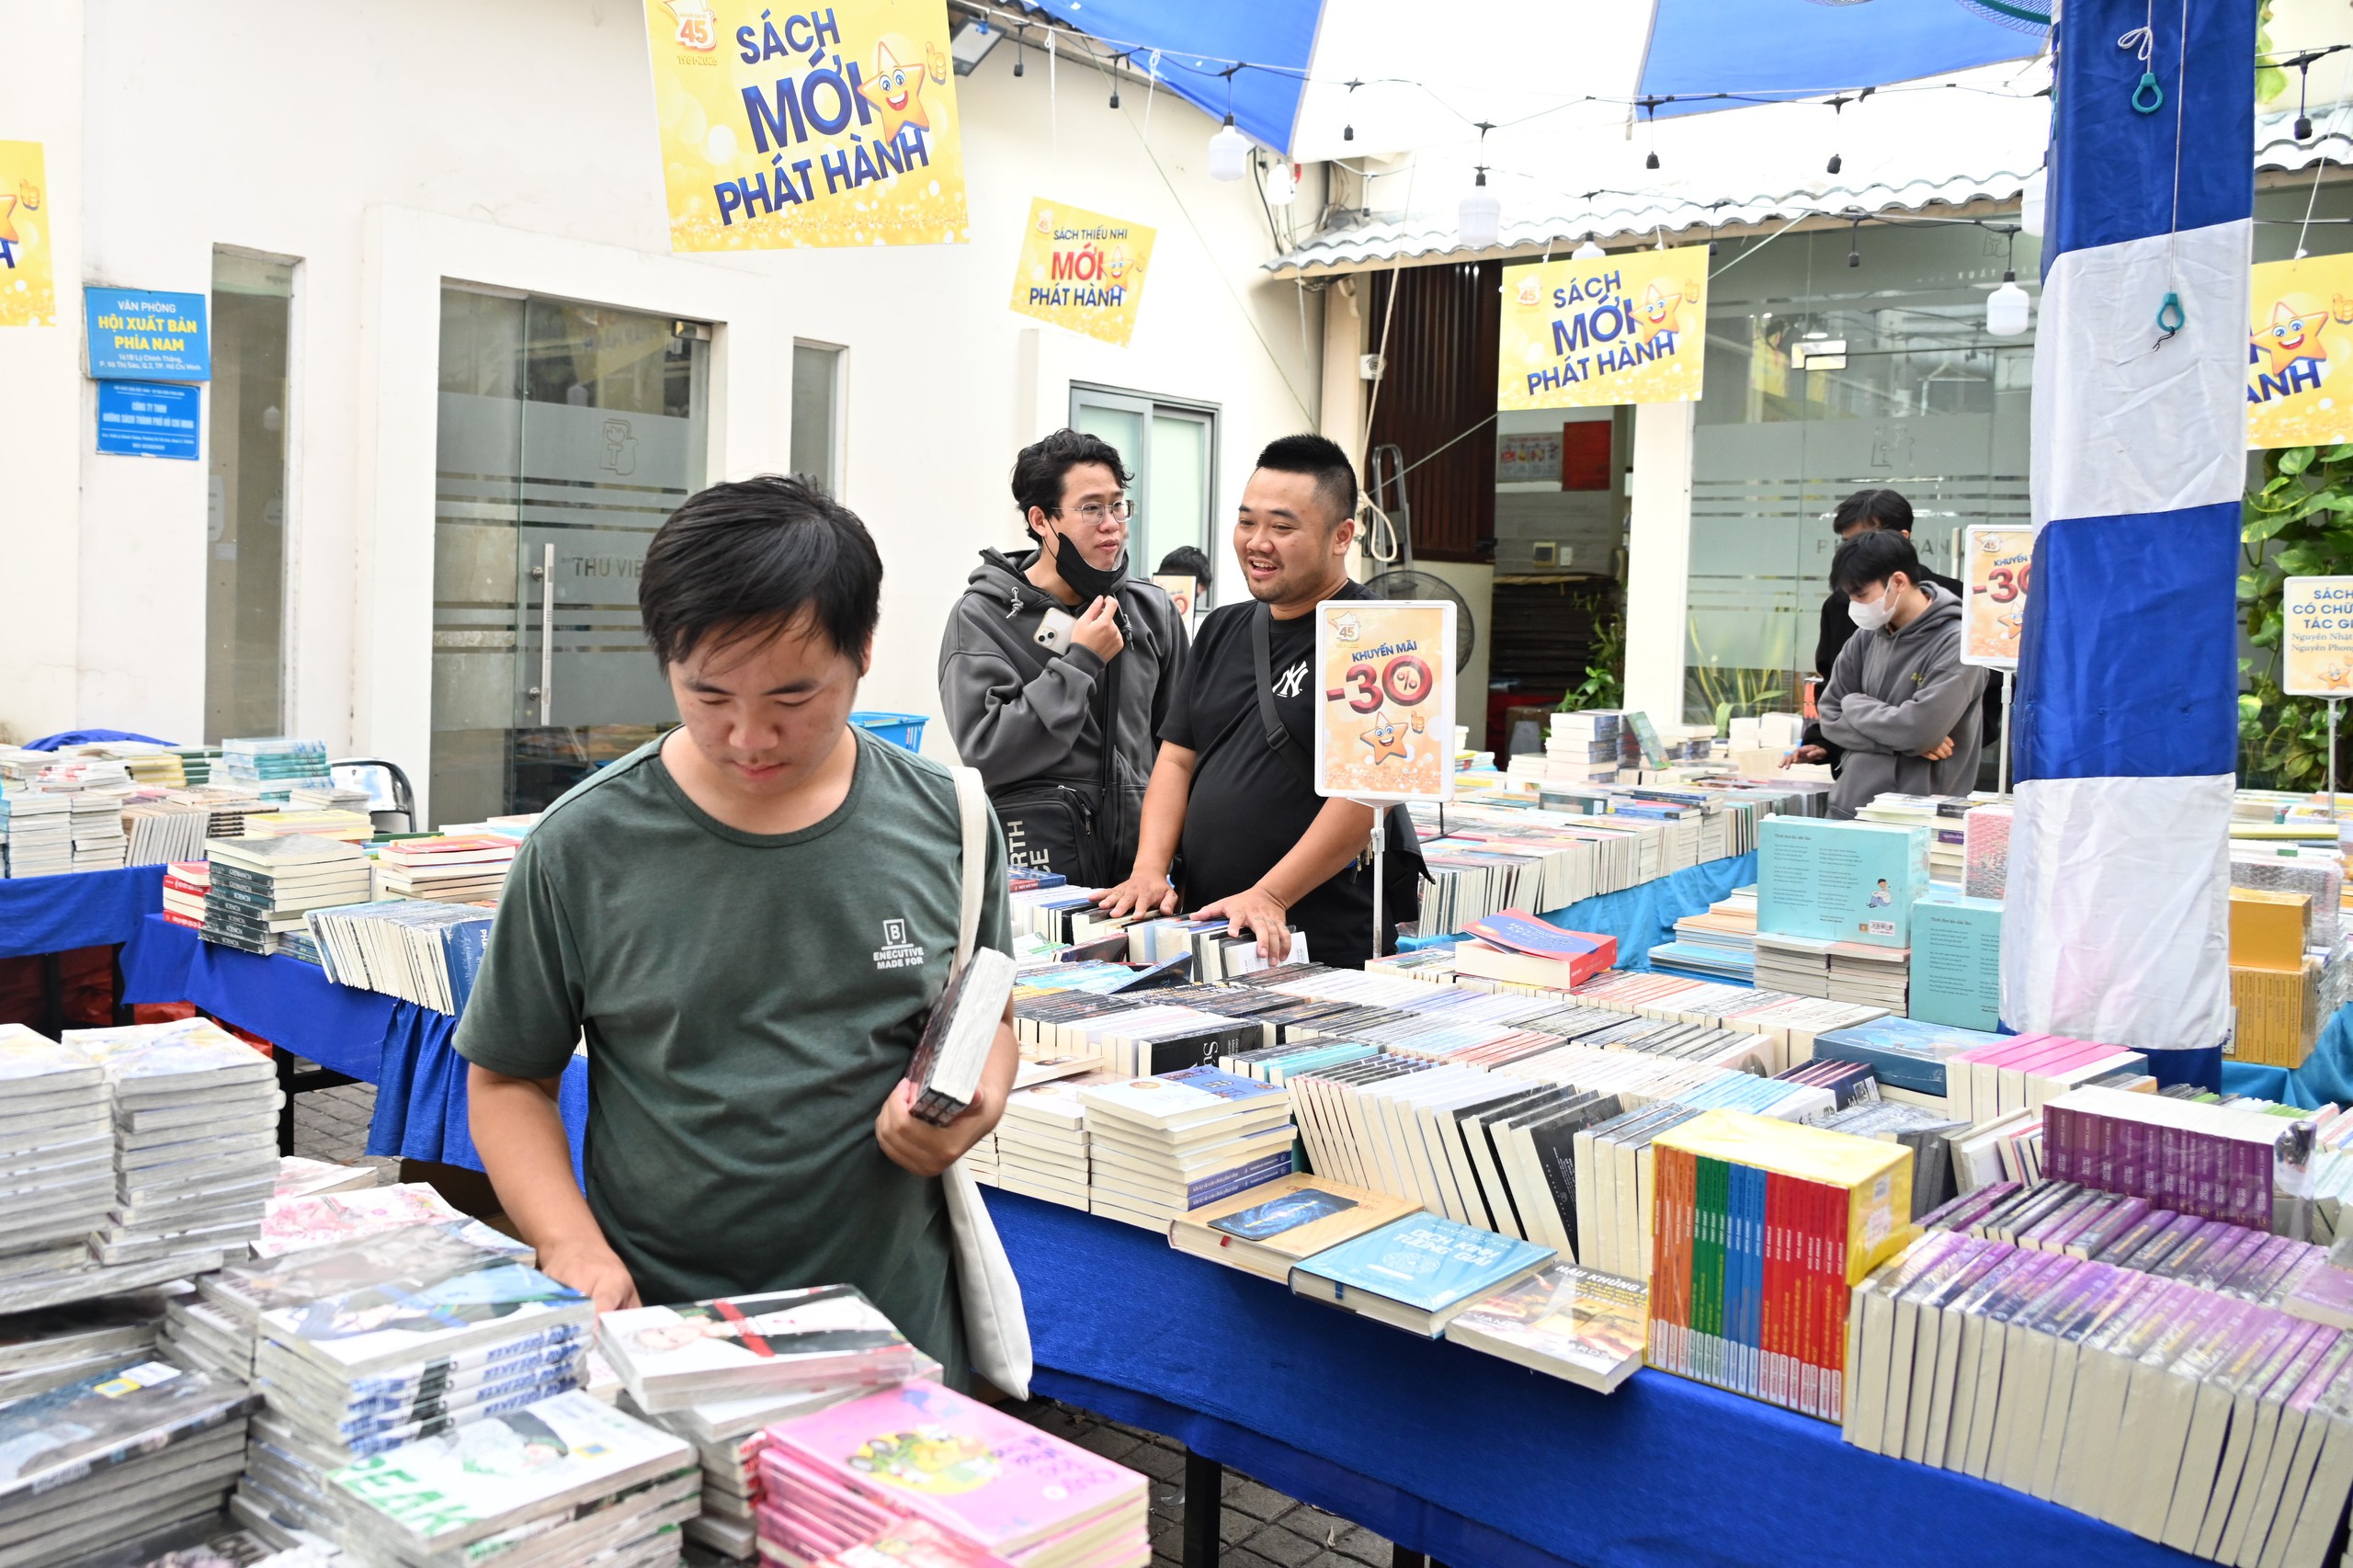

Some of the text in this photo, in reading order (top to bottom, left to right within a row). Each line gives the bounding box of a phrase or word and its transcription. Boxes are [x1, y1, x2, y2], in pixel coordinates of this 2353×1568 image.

[680, 18, 709, 44] 45
[736, 7, 840, 65] SÁCH
[741, 47, 872, 154] MỚI
[713, 128, 929, 226] PHÁT HÀNH
[1053, 224, 1127, 240] SÁCH THIẾU NHI
[1051, 243, 1105, 280] MỚI
[1029, 282, 1122, 306] PHÁT HÀNH
[1520, 290, 1535, 301] 45
[1553, 270, 1621, 308] SÁCH
[118, 300, 176, 313] VĂN PHÒNG
[98, 313, 198, 333] HỘI XUẤT BẢN
[1552, 293, 1636, 356] MỚI
[114, 334, 185, 351] PHÍA NAM
[1527, 332, 1675, 395] PHÁT HÀNH
[1984, 540, 1996, 550] 45
[1994, 553, 2028, 566] KHUYẾN
[573, 555, 644, 582] THƯ VIỆ
[2313, 587, 2353, 599] SÁCH
[2292, 602, 2315, 614] CÓ
[2303, 617, 2333, 629] TÁC
[1339, 627, 1354, 638] 45
[1351, 640, 1417, 663] KHUYẾN MÃI
[890, 925, 901, 939] B
[877, 957, 924, 970] MADE FOR
[1454, 1241, 1501, 1258] KINH
[1586, 1274, 1641, 1292] KHỦNG
